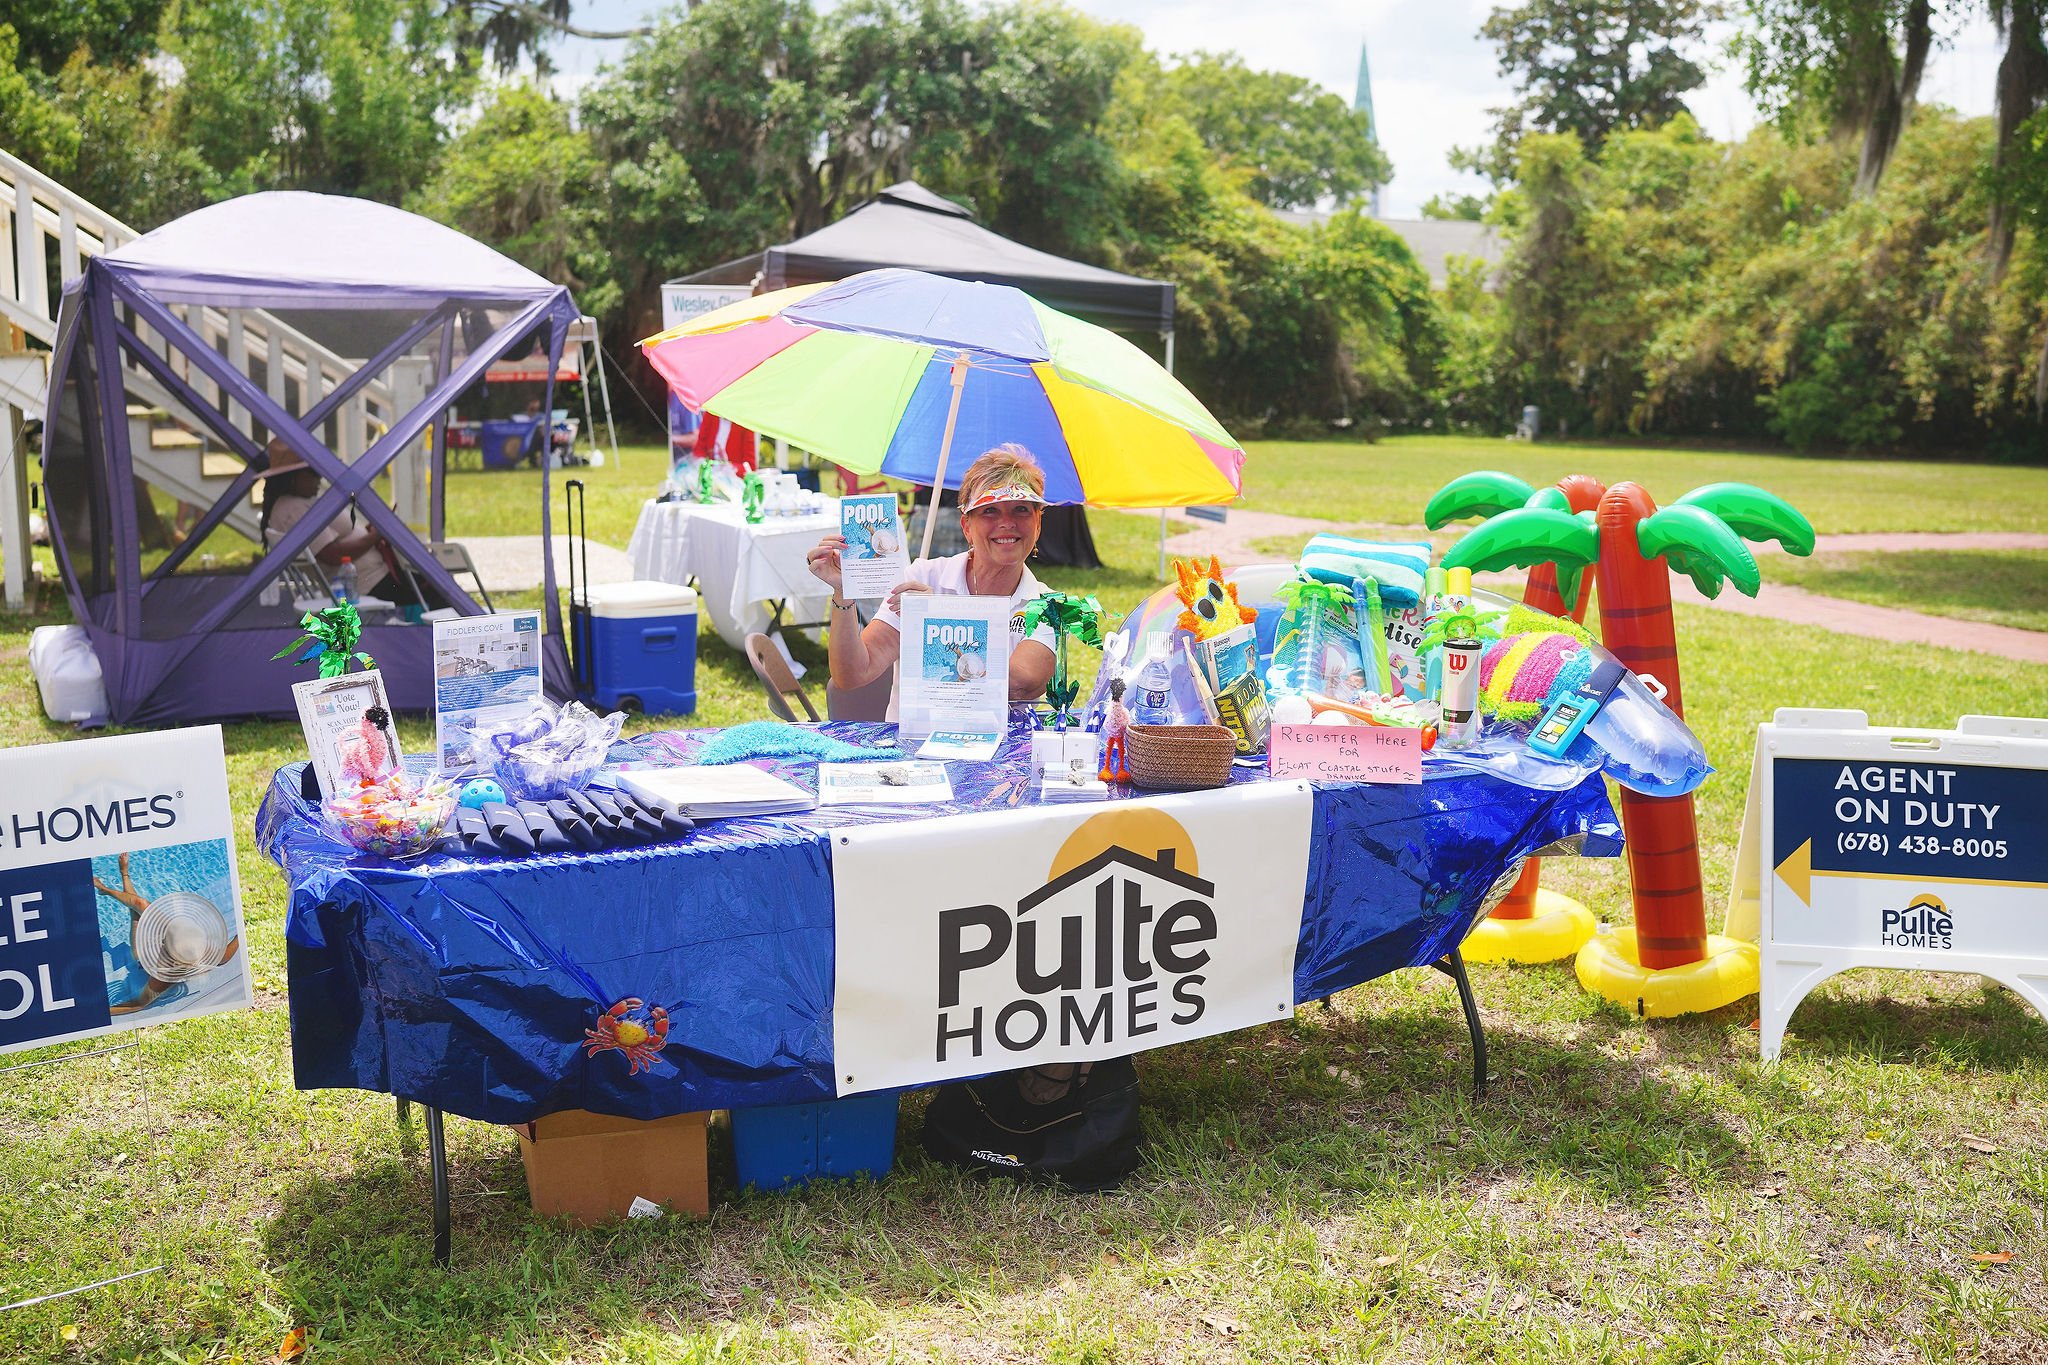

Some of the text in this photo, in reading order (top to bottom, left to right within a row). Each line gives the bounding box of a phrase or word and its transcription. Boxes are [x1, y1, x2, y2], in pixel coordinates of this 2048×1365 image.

[672, 295, 717, 313] Wesley
[844, 503, 889, 525] POOL
[447, 623, 504, 636] FIDDLER'S COVE
[926, 624, 980, 648] POOL
[335, 693, 355, 704] Vote
[336, 701, 361, 714] Now!
[1218, 698, 1251, 752] NITRO
[936, 732, 988, 740] POOL
[1281, 726, 1359, 746] REGISTER
[1339, 747, 1360, 758] FOR
[1278, 757, 1312, 770] FLOAT
[1318, 761, 1361, 773] COASTAL
[1327, 773, 1367, 781] DRAWING
[1834, 765, 1957, 796] AGENT
[1835, 797, 2001, 830] ON DUTY
[1837, 832, 2008, 859] (678) 438-8005
[0, 891, 48, 946] E
[1882, 908, 1954, 937] Pulte
[938, 874, 1218, 1009] Pulte
[1882, 933, 1952, 950] HOMES
[936, 974, 1207, 1063] HOMES
